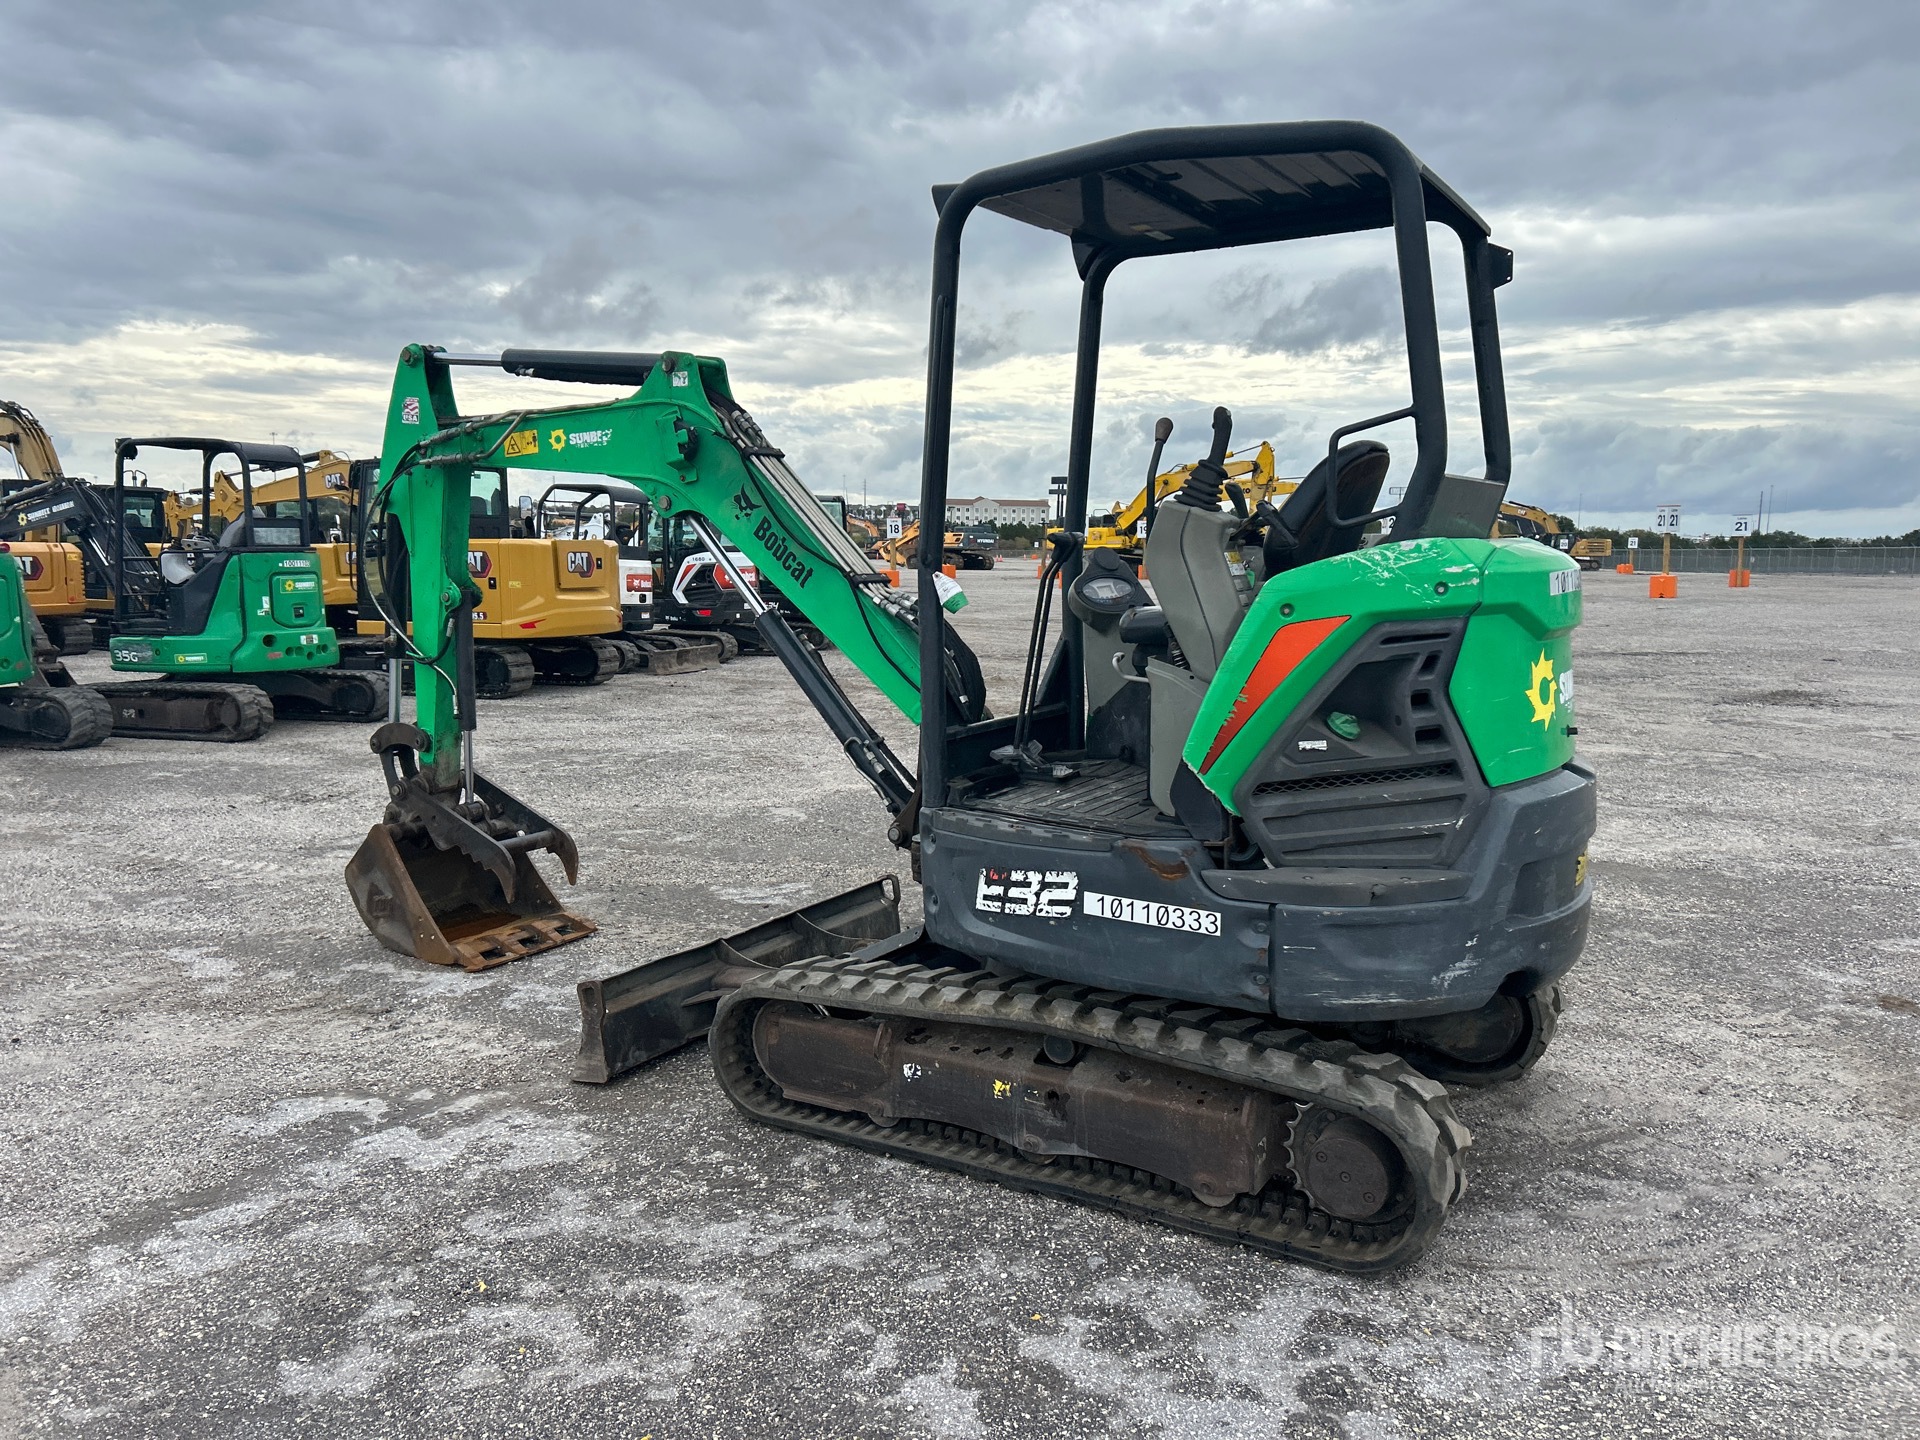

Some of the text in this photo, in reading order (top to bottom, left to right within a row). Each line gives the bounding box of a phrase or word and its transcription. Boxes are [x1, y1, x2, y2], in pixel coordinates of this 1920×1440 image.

[569, 428, 613, 445] SUNBE
[325, 473, 341, 489] CAT
[1657, 514, 1666, 526] 21
[1669, 514, 1679, 526] 21
[1734, 521, 1748, 532] 21
[889, 524, 900, 534] 18
[753, 515, 814, 589] Bobcat
[467, 551, 483, 572] AT
[567, 552, 589, 572] CAT
[113, 649, 139, 662] 35G
[1096, 895, 1220, 935] 10110333
